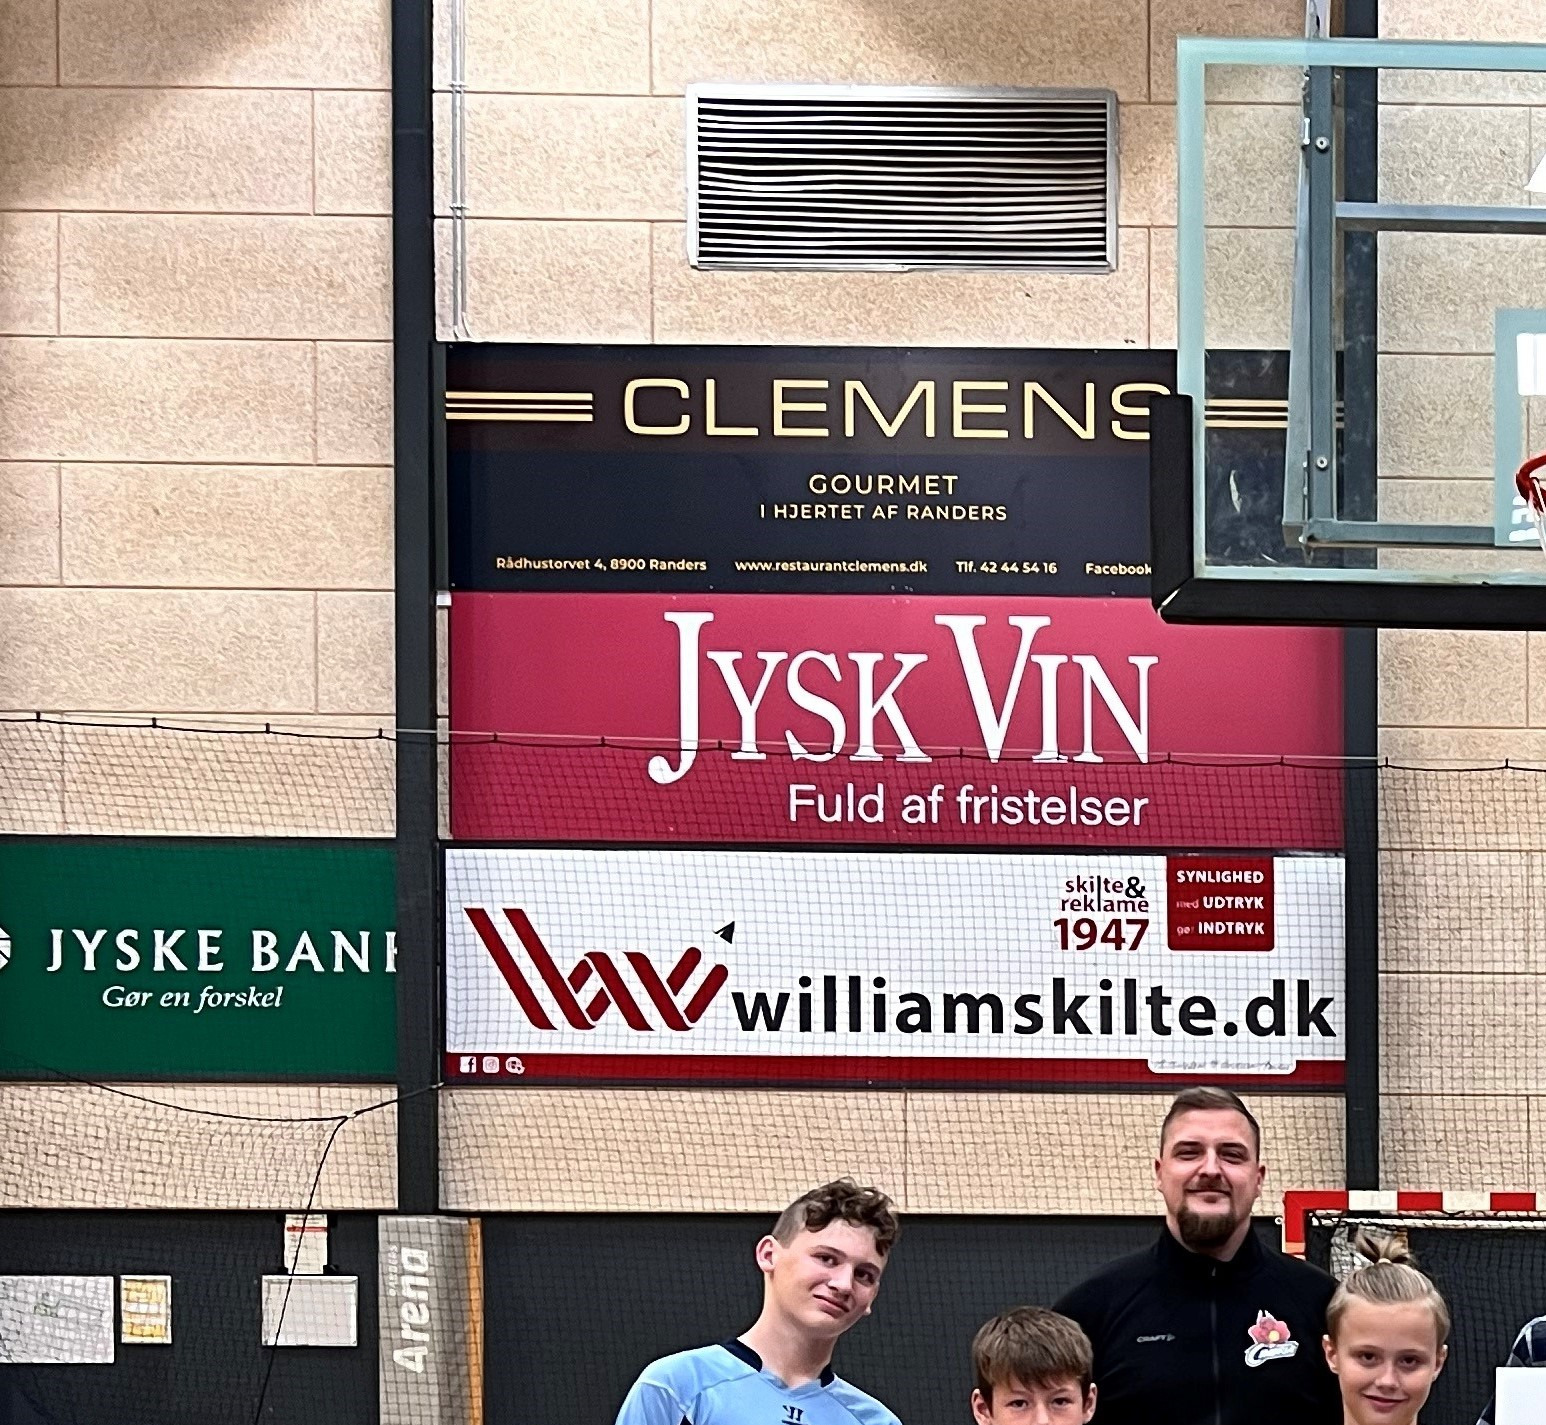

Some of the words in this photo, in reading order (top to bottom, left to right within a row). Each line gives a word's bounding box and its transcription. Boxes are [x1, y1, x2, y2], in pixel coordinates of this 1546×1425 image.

[622, 377, 1171, 441] CLEMENS
[808, 474, 959, 496] GOURMET
[760, 503, 765, 519] I
[774, 503, 865, 520] HJERTET
[871, 504, 899, 520] AF
[906, 504, 1008, 521] RANDERS
[495, 556, 591, 571] Rådhustorvet
[593, 558, 607, 573] 4,
[609, 558, 646, 572] 8900
[648, 558, 707, 573] Randers
[733, 559, 929, 574] www.restaurantclemens.dk
[955, 560, 977, 574] Tlf.
[979, 561, 998, 574] 42
[1000, 561, 1020, 575] 44
[1021, 562, 1040, 575] 54
[1042, 562, 1058, 575] 16
[647, 610, 933, 785] JYSK
[934, 614, 1160, 765] VIN
[788, 782, 886, 825] Fuld
[901, 782, 946, 826] af
[956, 783, 1149, 827] fristelser
[1176, 869, 1265, 884] SYNLIGHED
[1061, 893, 1150, 913] reklame
[1203, 895, 1265, 909] UDTRYK
[1053, 917, 1150, 951] 1947
[1198, 921, 1265, 935] INDTRYK
[46, 929, 224, 973] JYSKE
[102, 985, 154, 1008] Gør
[159, 990, 191, 1008] en
[193, 985, 285, 1014] forskel
[730, 974, 1338, 1039] williamskilte.dk
[392, 1246, 430, 1374] Arena
